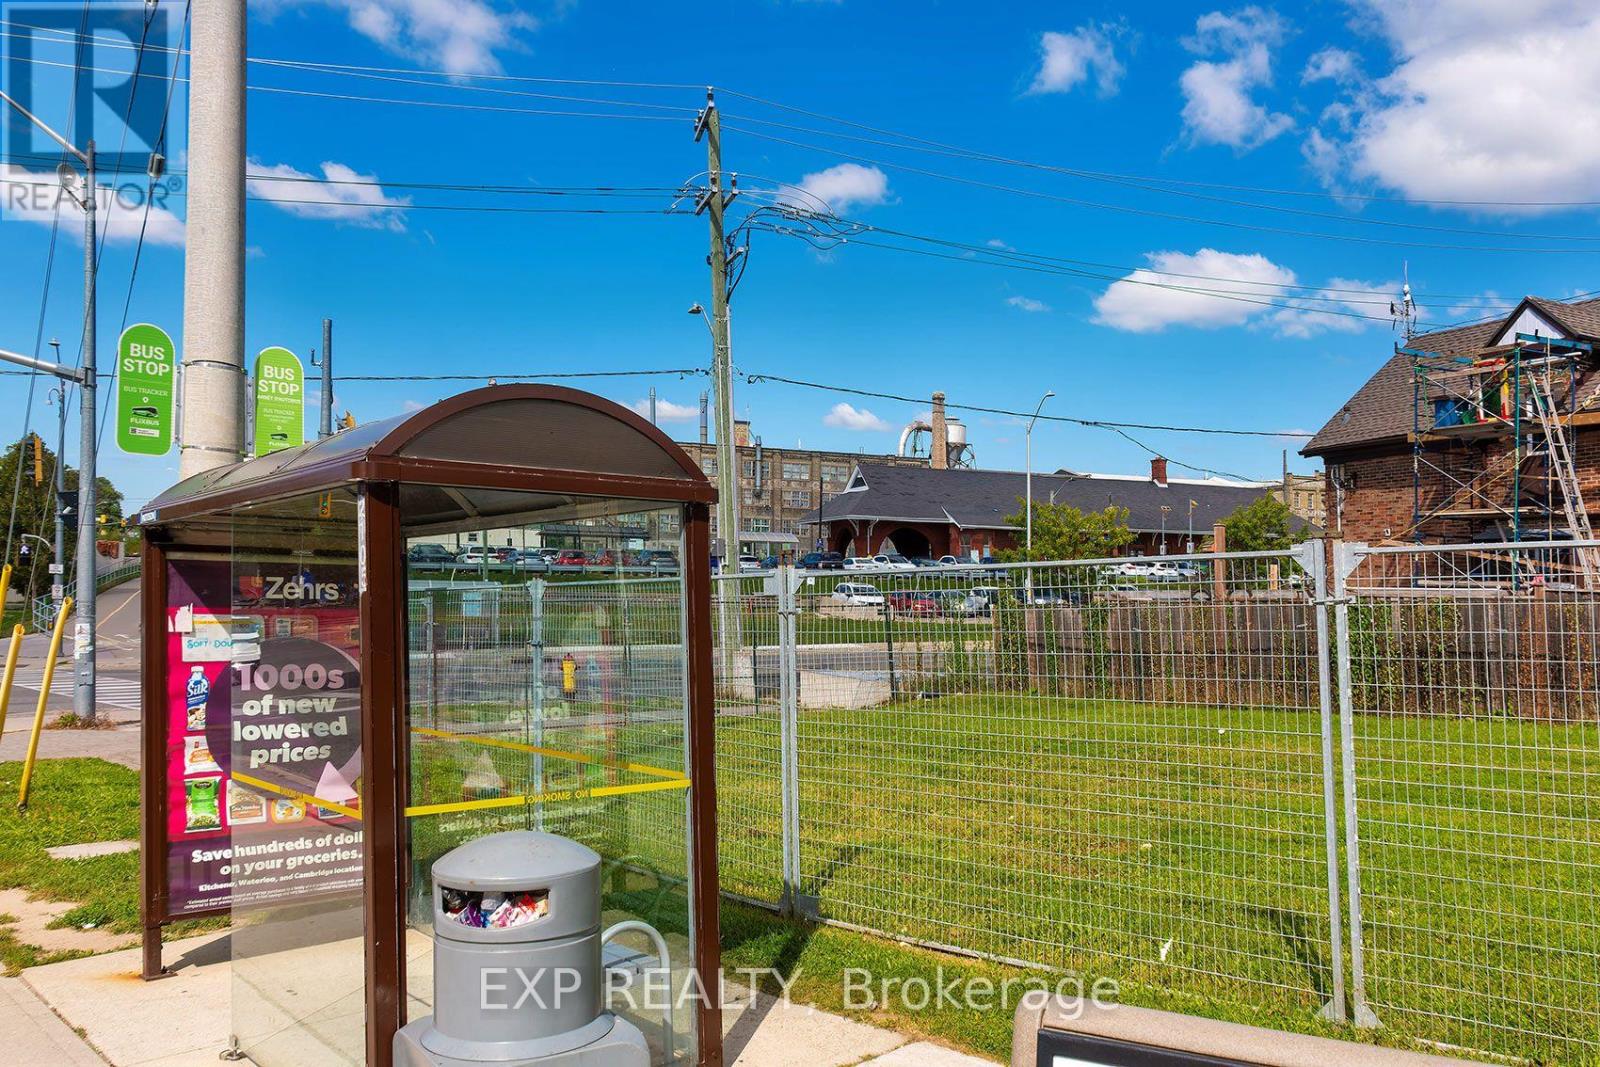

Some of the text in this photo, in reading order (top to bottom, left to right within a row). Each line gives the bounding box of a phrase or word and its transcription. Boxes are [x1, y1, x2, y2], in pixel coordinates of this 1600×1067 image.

[130, 343, 165, 360] BUS
[123, 358, 170, 376] STOP
[264, 365, 295, 380] BUS
[123, 385, 169, 397] BUS TRACKER
[258, 379, 300, 395] STOP
[130, 417, 160, 426] FLIXBUS
[265, 576, 340, 600] Zehrs
[237, 663, 345, 691] 1000s
[242, 694, 337, 716] of new
[233, 716, 348, 741] lowered
[249, 741, 332, 769] prices
[191, 848, 233, 863] Save
[234, 837, 313, 858] hundreds
[315, 834, 333, 848] of
[219, 848, 363, 875] on your groceries.
[238, 876, 278, 887] Waterloo,
[279, 873, 294, 882] and
[294, 868, 334, 879] Cambridge
